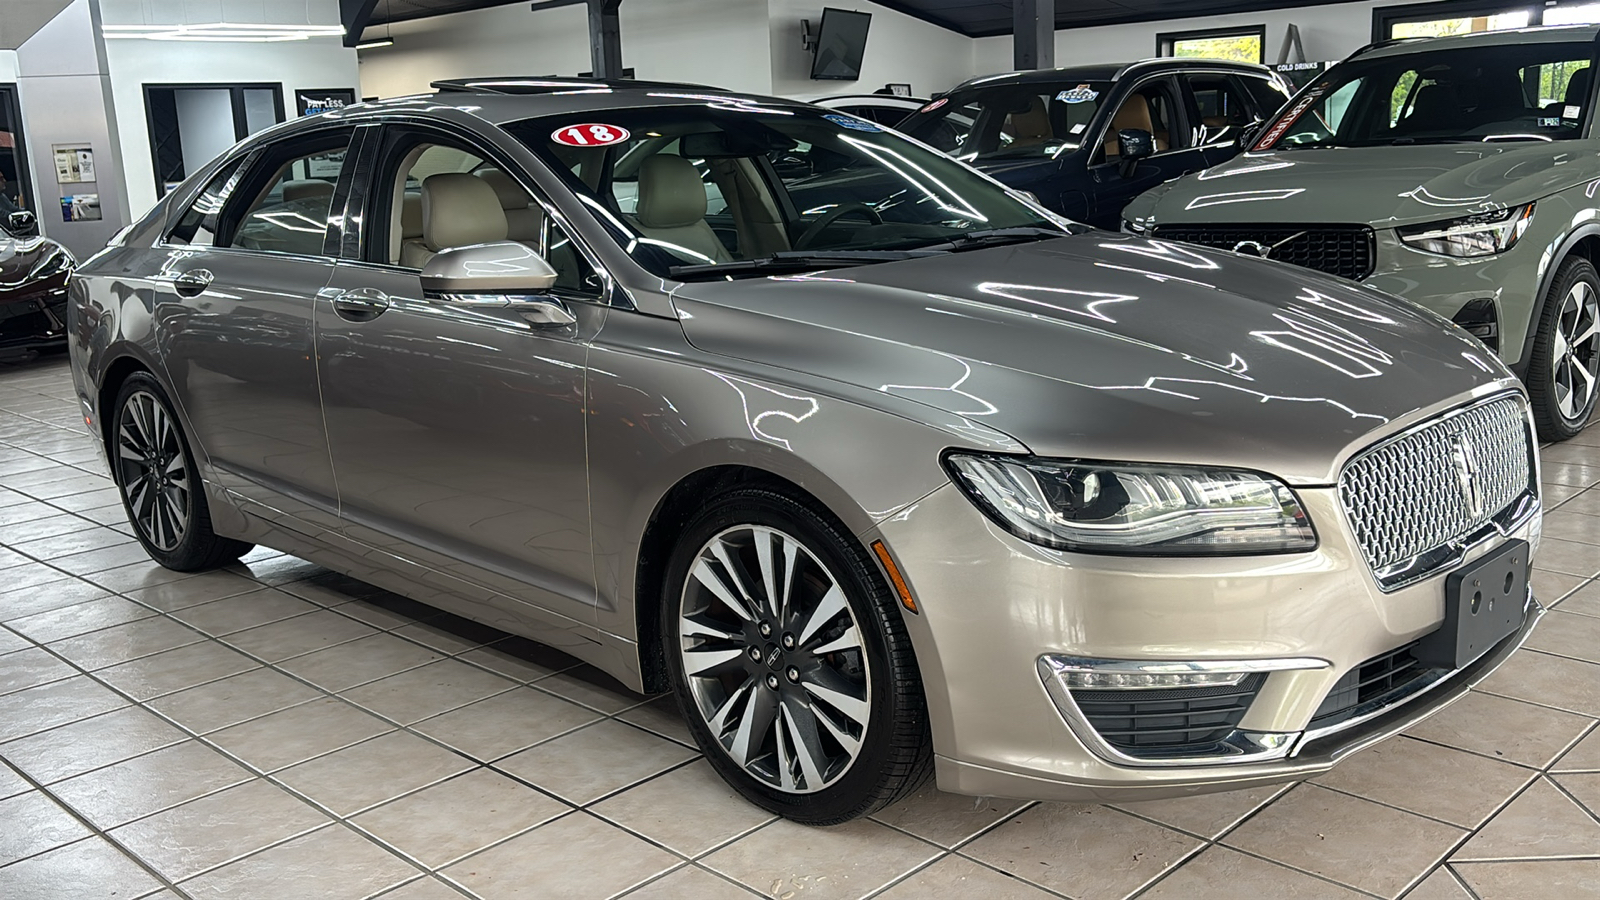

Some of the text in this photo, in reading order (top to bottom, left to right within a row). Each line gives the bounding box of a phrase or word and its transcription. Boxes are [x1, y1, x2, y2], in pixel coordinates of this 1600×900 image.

[1277, 62, 1318, 72] COLD DRINKS
[307, 99, 322, 108] PAY
[1260, 97, 1314, 147] CERTIFIED
[567, 125, 615, 145] 18
